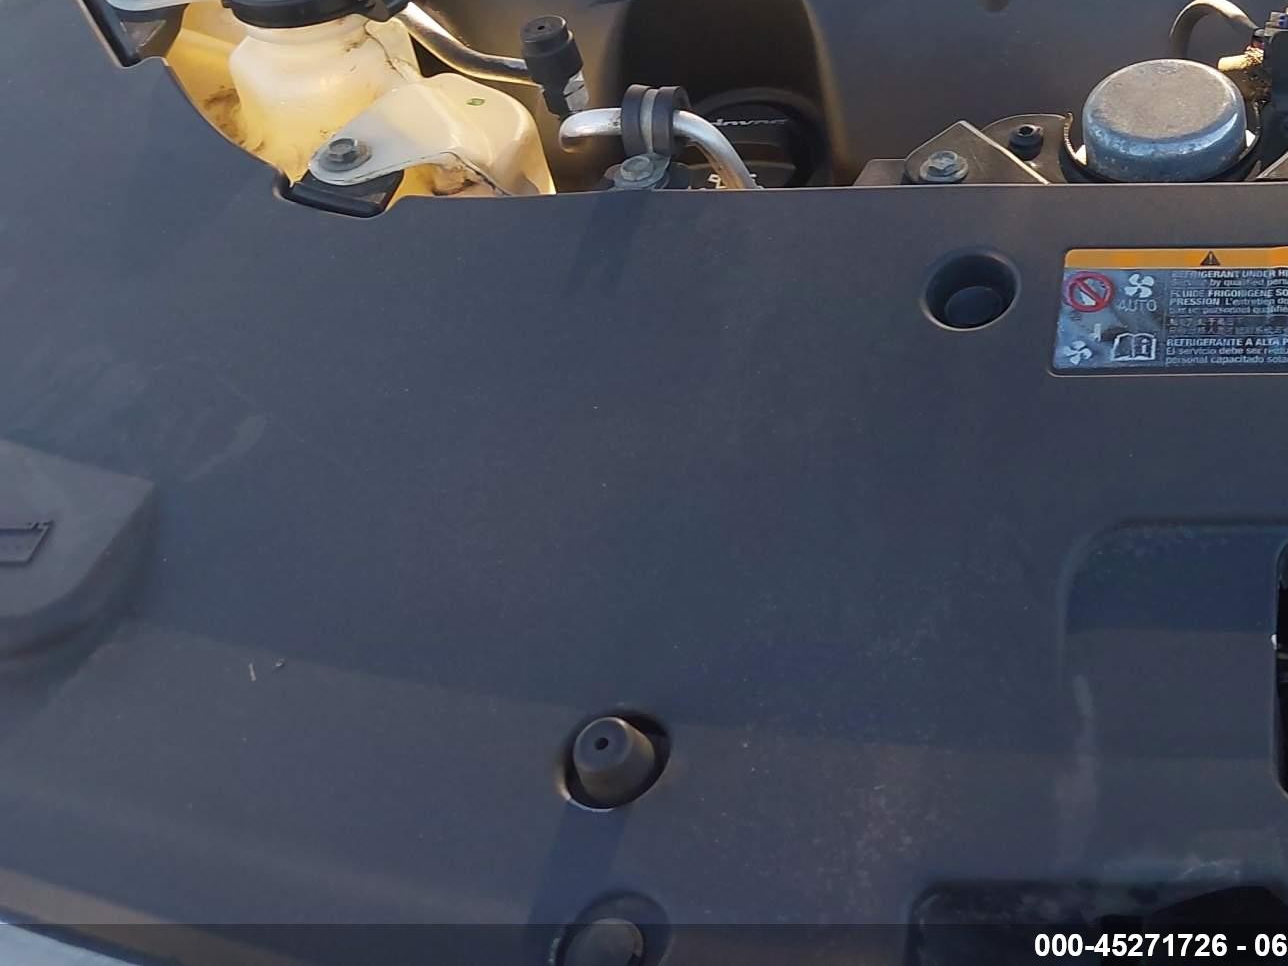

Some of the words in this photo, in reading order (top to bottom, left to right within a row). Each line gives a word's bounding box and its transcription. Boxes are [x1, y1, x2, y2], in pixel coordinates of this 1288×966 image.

[1209, 278, 1222, 286] by
[1244, 338, 1254, 346] A
[1255, 338, 1280, 346] ALTA
